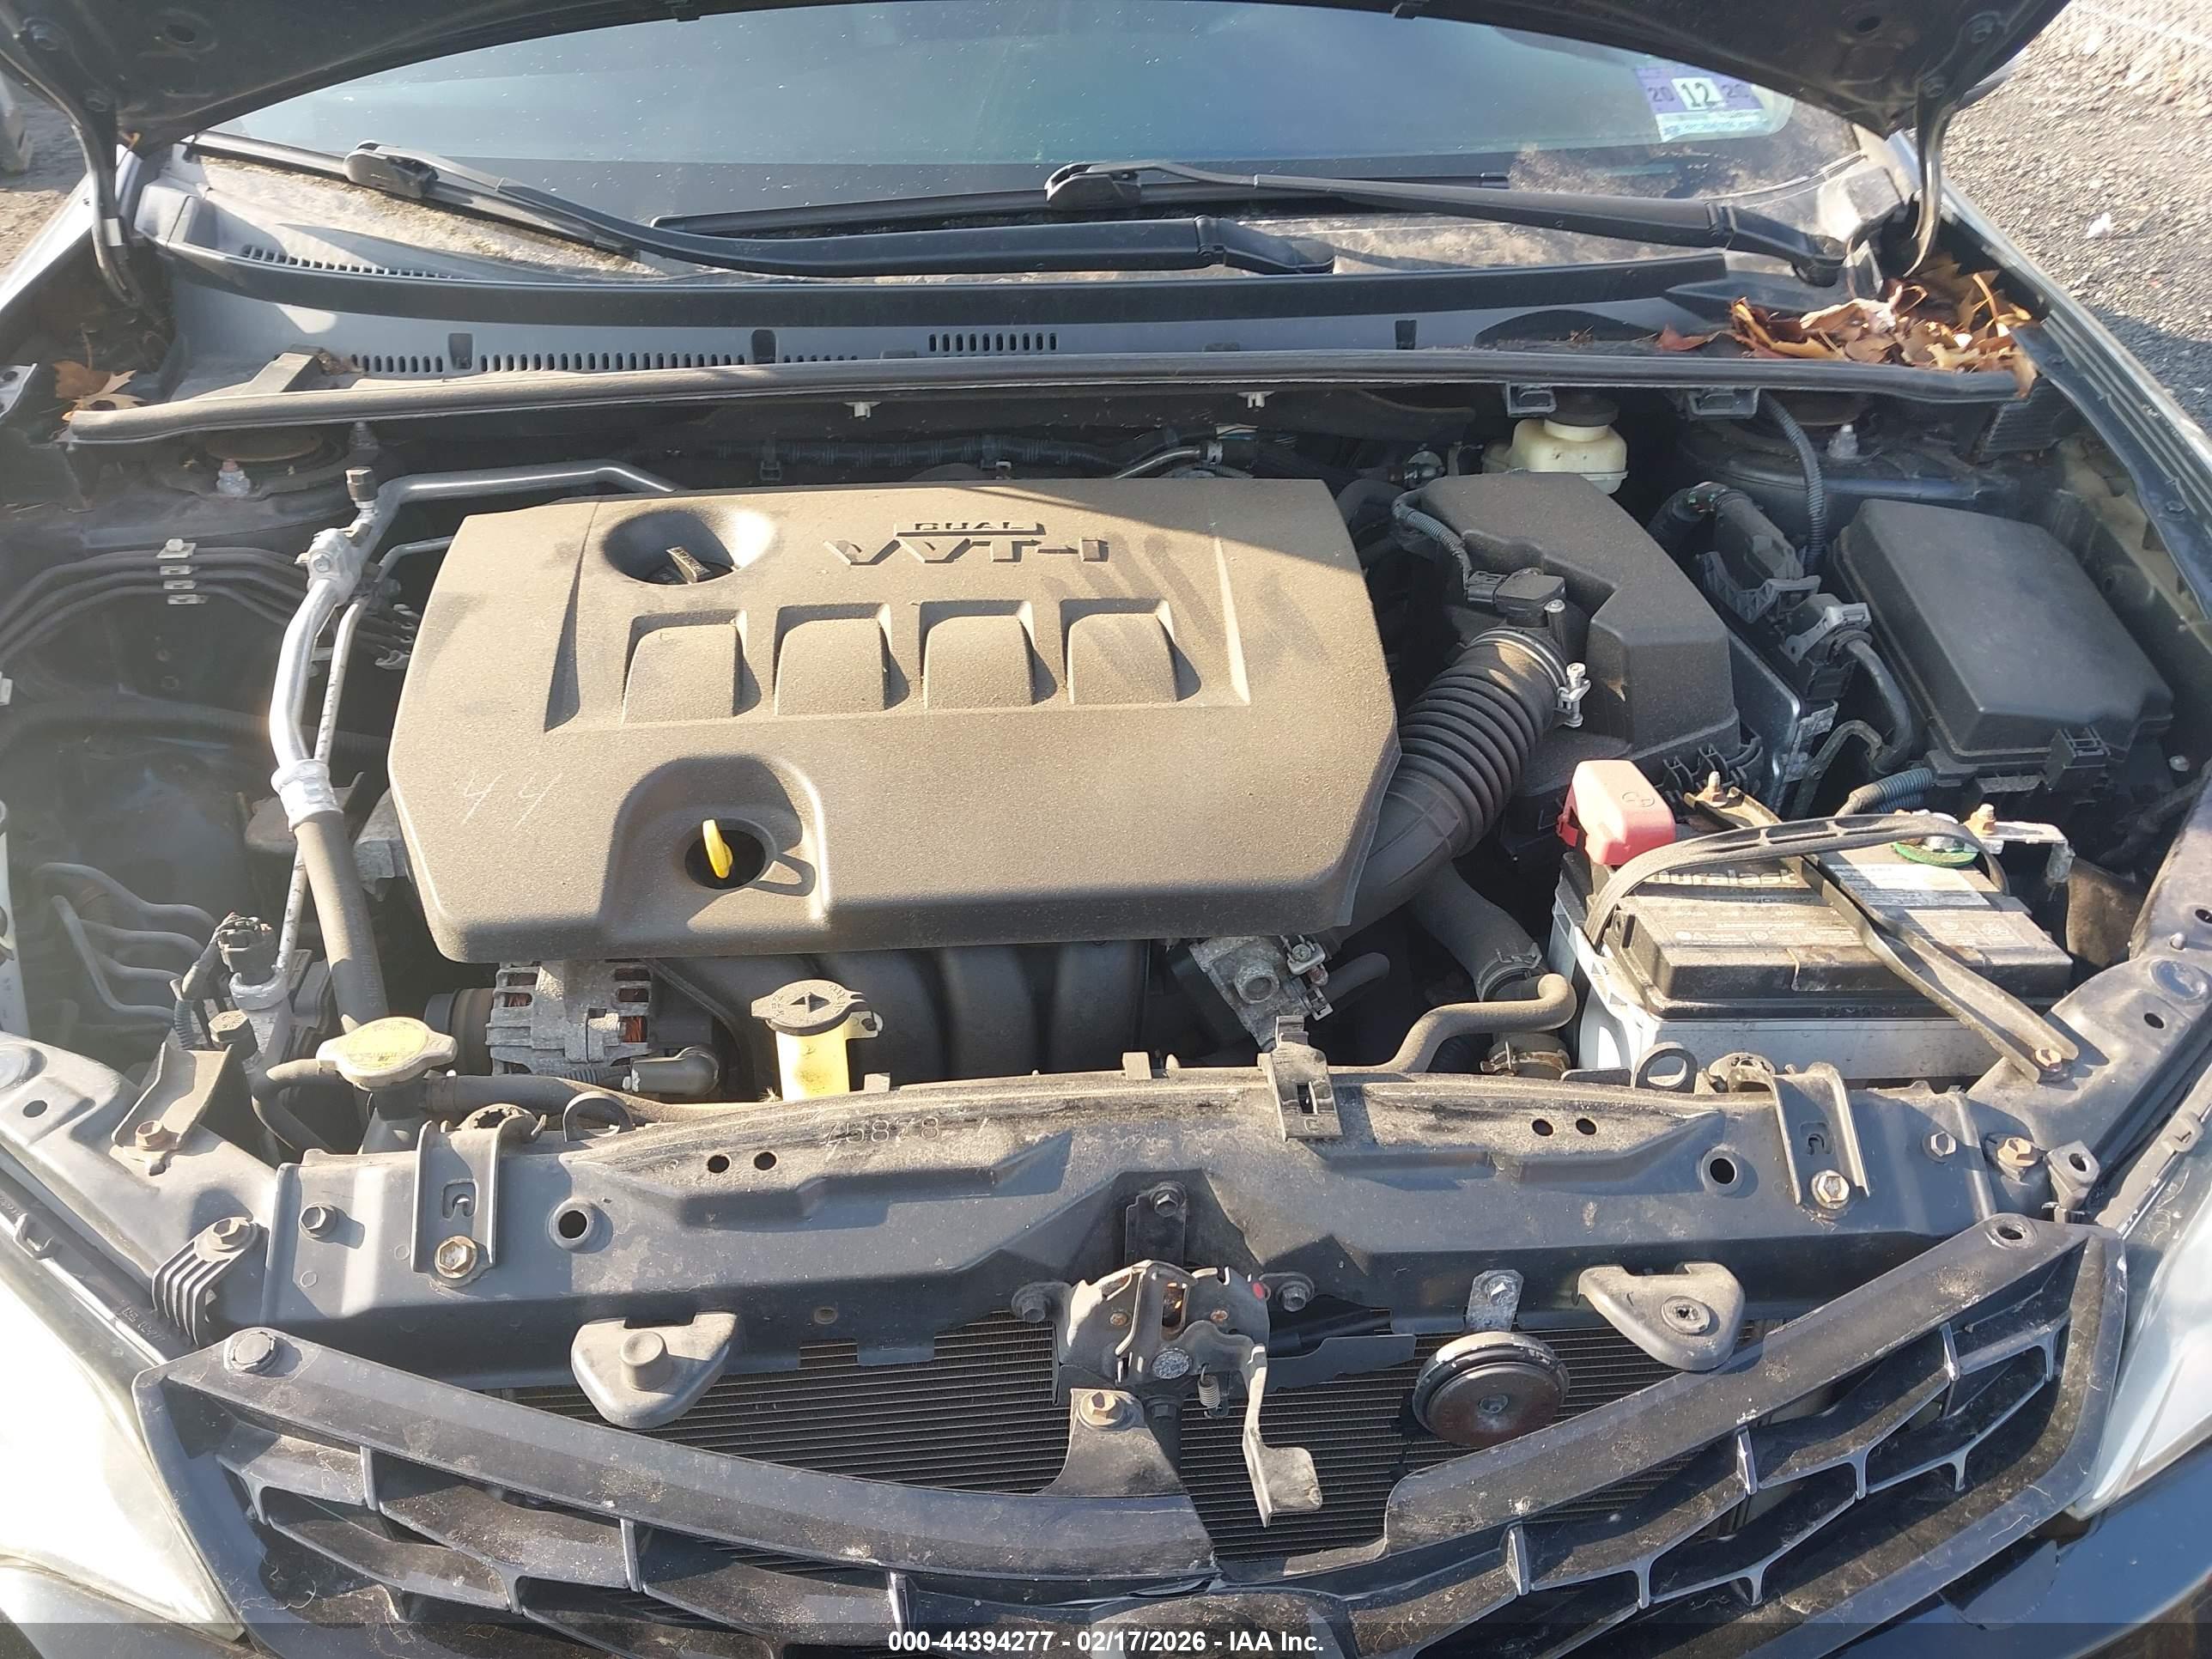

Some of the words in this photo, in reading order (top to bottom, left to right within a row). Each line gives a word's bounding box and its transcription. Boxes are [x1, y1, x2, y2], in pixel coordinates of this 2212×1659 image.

[1647, 87, 1674, 102] 20
[1680, 82, 1717, 107] 12
[1647, 869, 1799, 887] duralast
